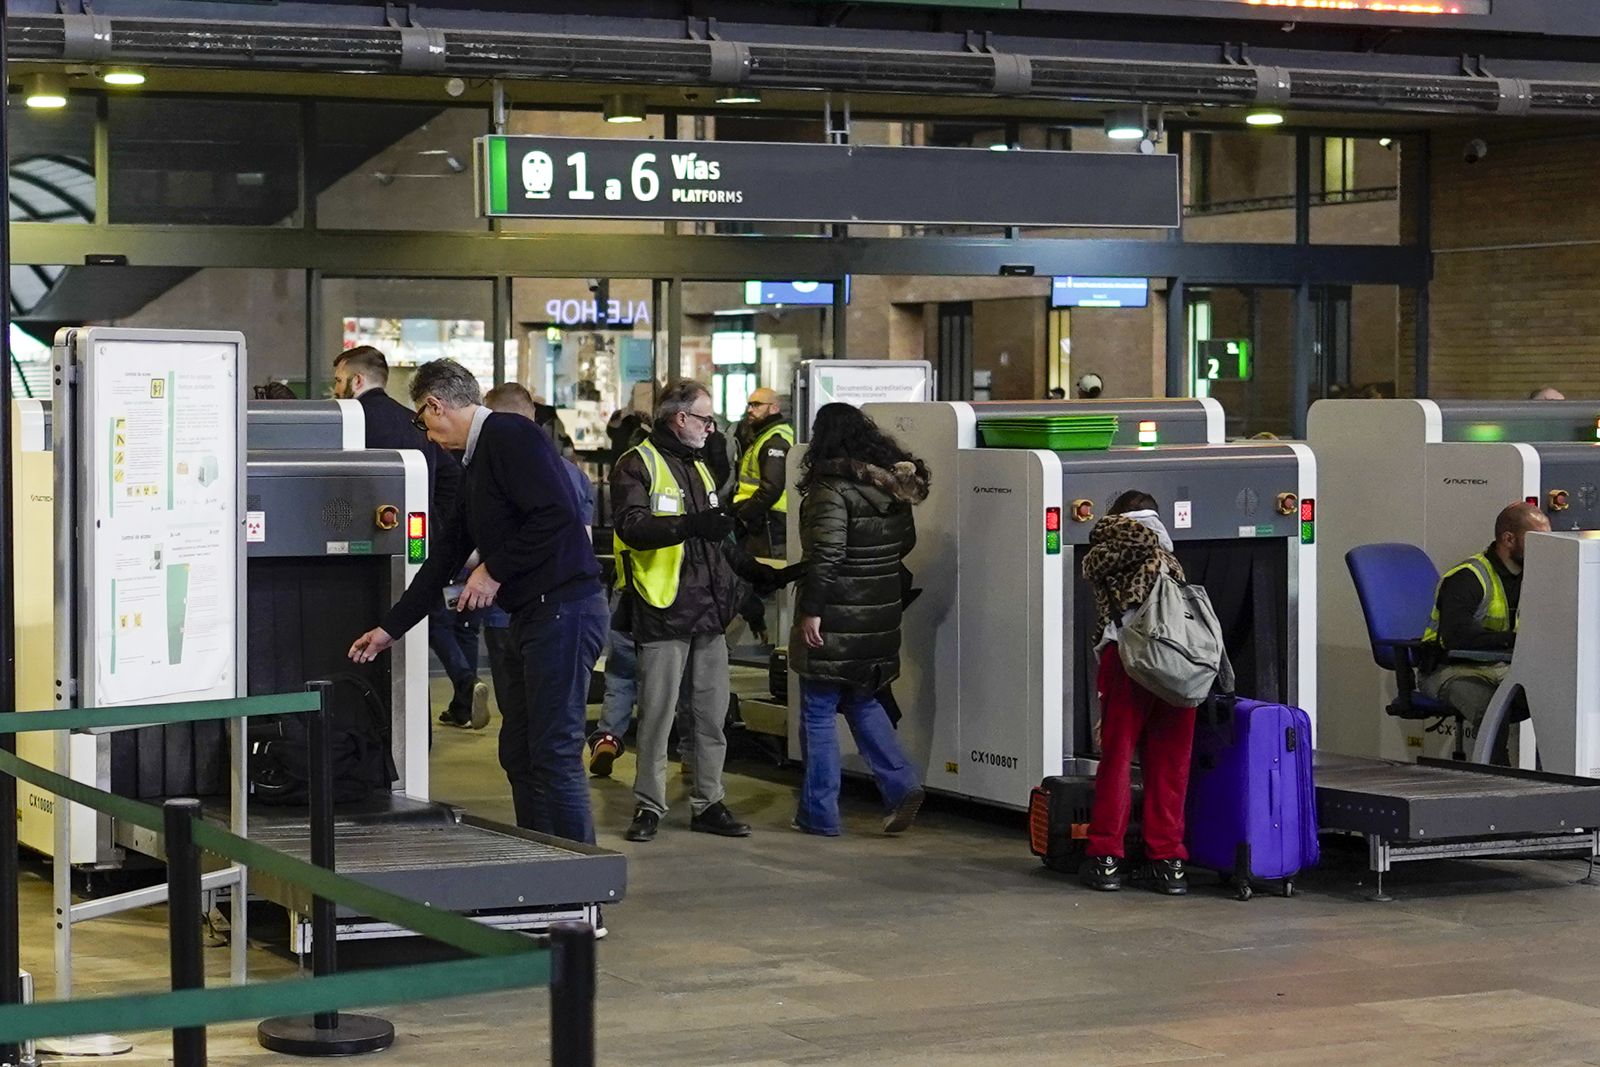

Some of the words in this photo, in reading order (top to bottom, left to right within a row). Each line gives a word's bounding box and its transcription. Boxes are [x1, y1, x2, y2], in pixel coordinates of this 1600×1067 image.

[567, 151, 595, 200] 1
[605, 178, 622, 201] a
[631, 152, 660, 201] 6
[671, 152, 721, 180] Vías
[672, 188, 743, 203] PLATFORMS
[1208, 358, 1219, 379] 2
[836, 384, 873, 392] Documentos
[971, 750, 1018, 770] CX10080T
